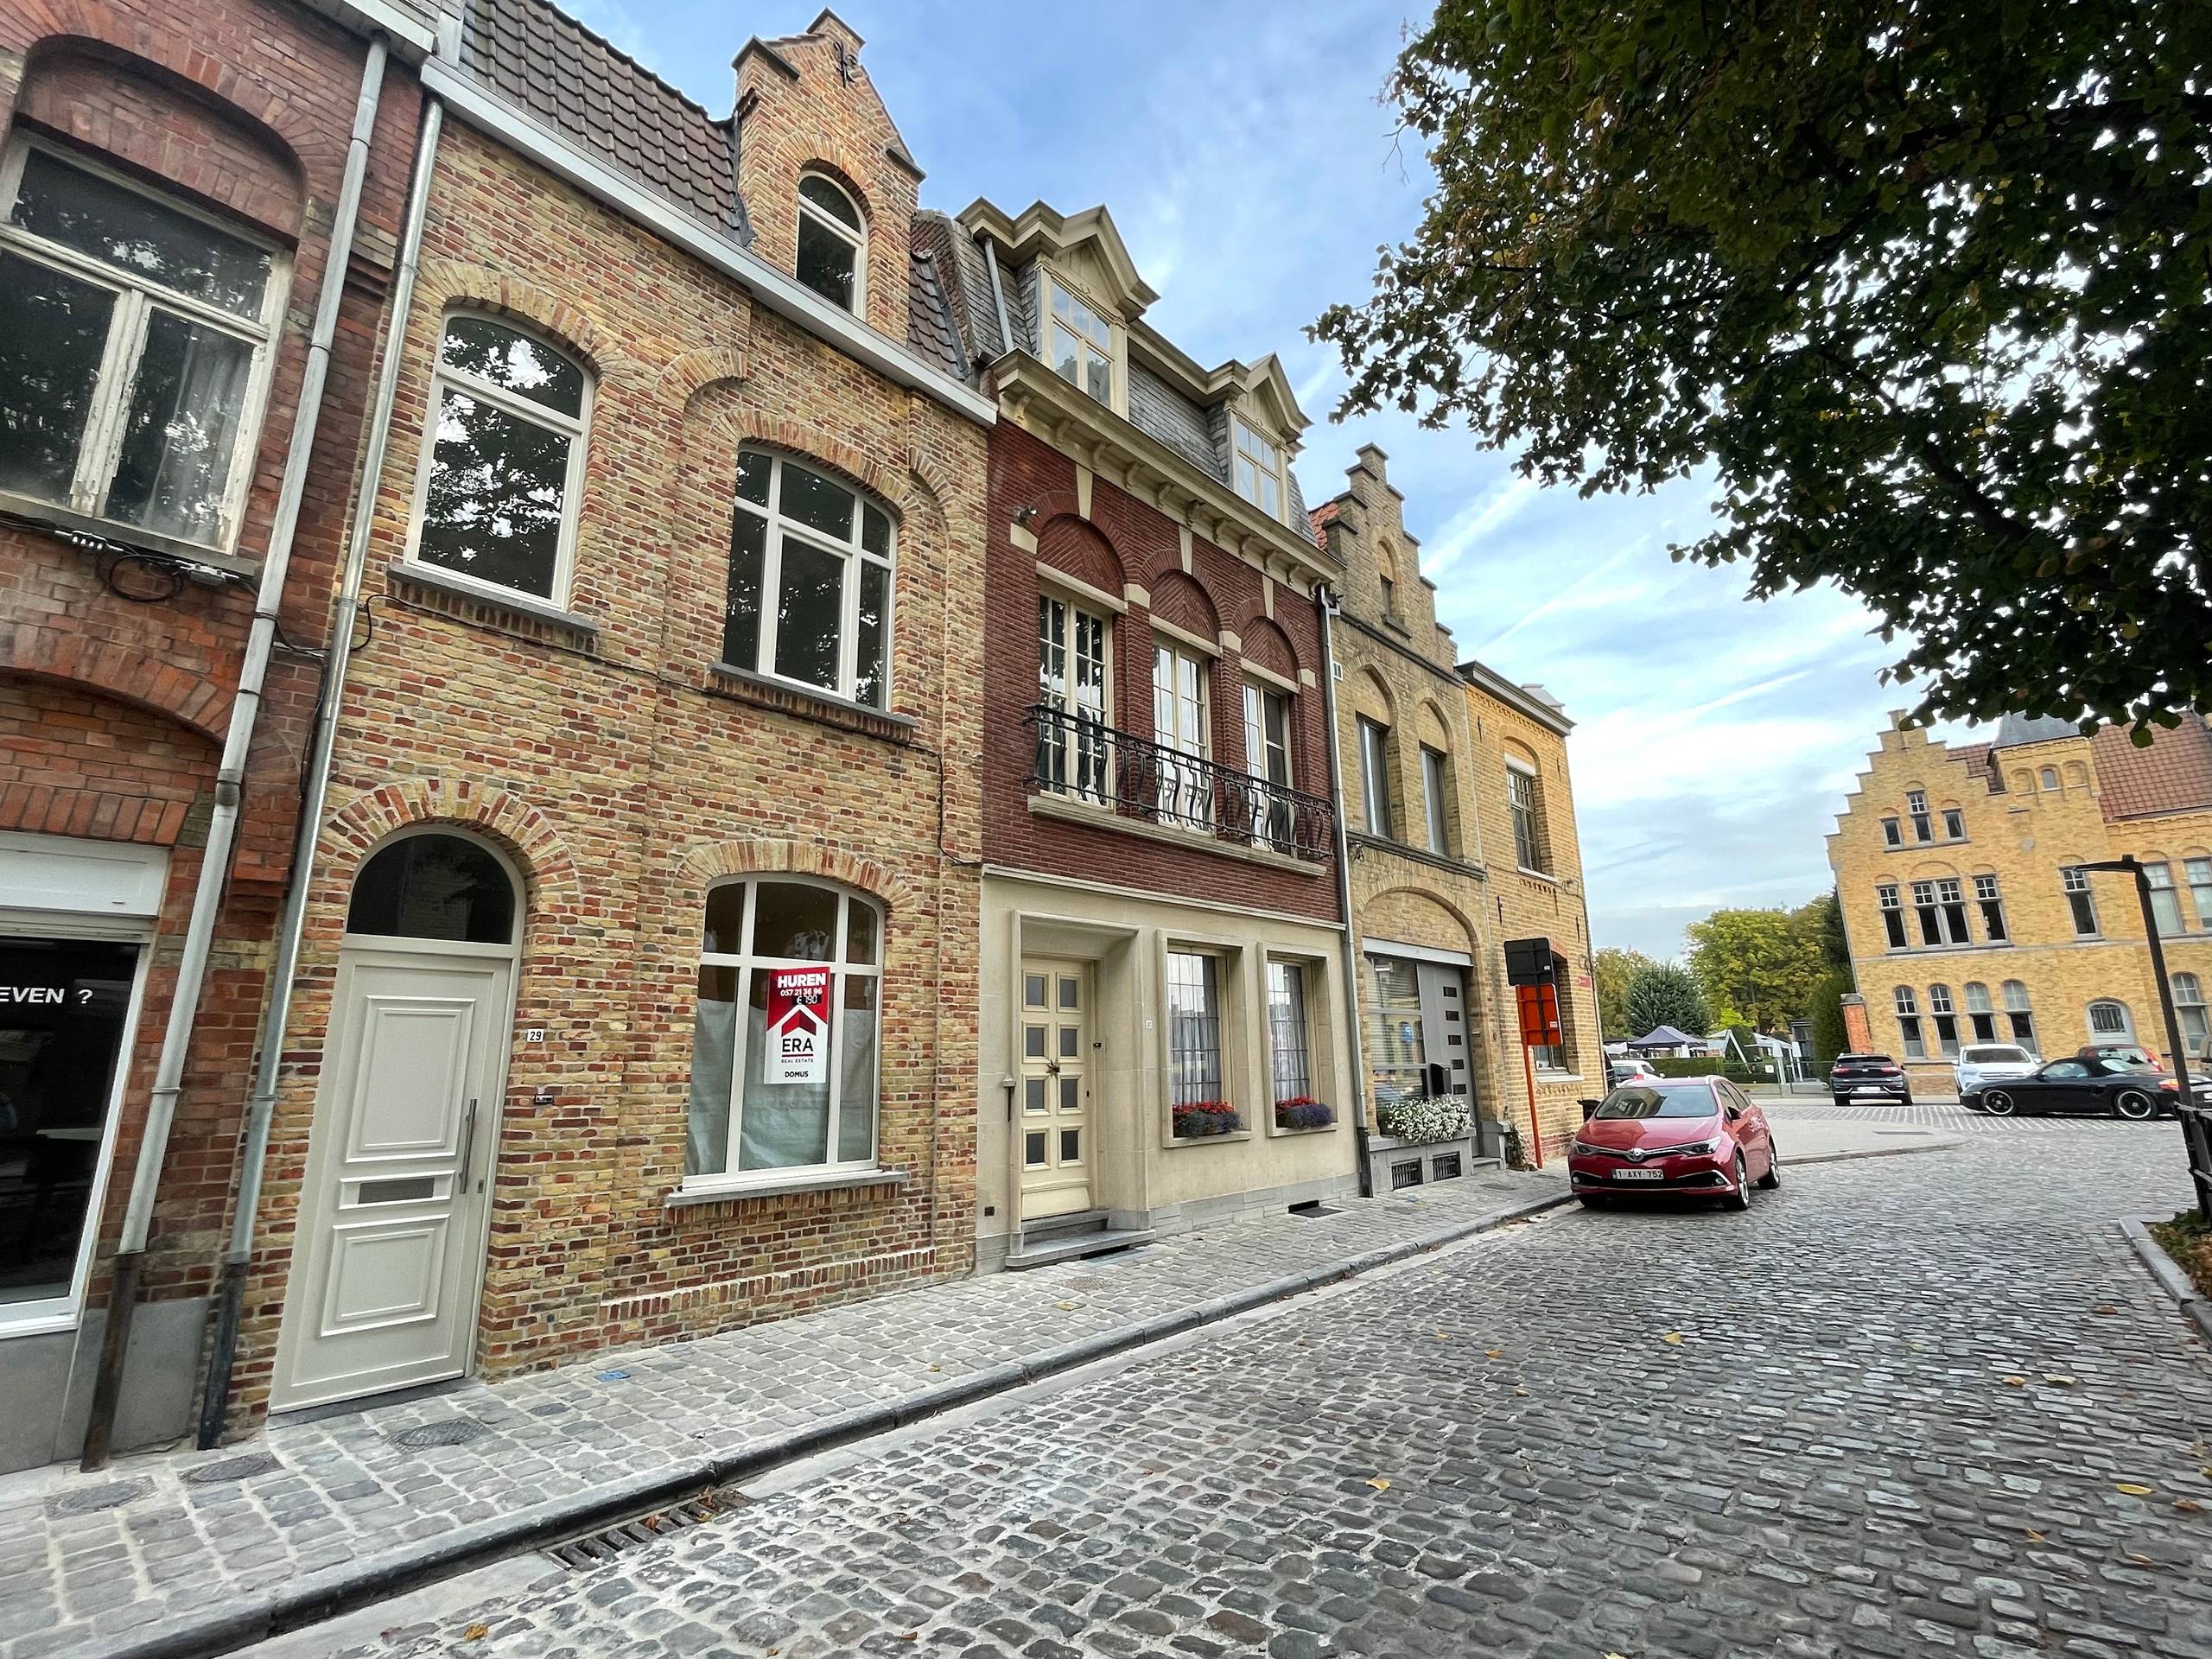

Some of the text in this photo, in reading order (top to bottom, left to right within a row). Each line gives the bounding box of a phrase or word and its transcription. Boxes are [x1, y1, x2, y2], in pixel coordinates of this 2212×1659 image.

[778, 973, 826, 988] HUREN
[78, 989, 93, 1004] ?
[530, 1032, 542, 1040] 29
[782, 1038, 814, 1052] ERA
